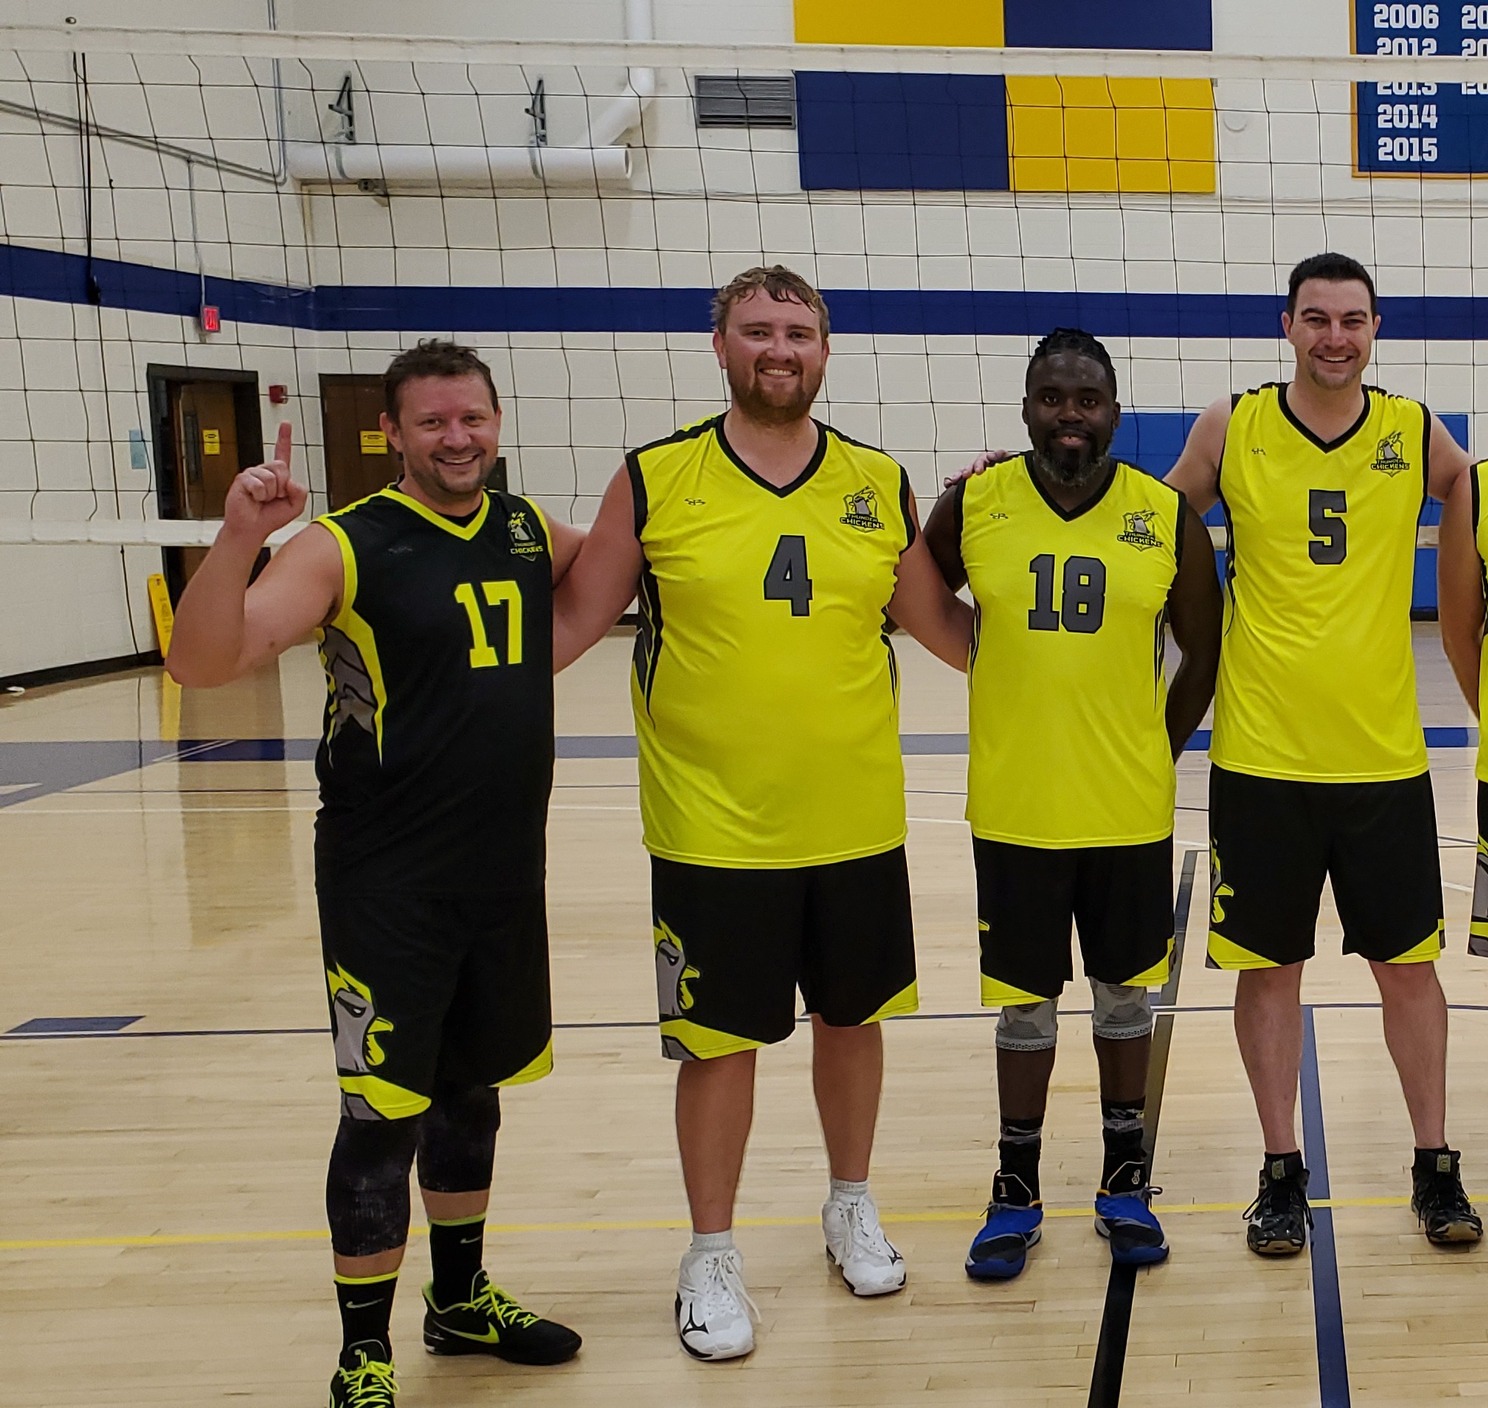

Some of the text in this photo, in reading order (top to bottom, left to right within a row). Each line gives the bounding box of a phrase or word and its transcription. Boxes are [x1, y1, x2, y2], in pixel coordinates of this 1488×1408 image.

[1373, 4, 1439, 29] 2006
[1376, 37, 1437, 56] 2012
[1377, 104, 1438, 129] 2014
[1377, 137, 1438, 162] 2015
[1308, 489, 1347, 565] 5
[763, 534, 813, 617] 4
[1027, 553, 1107, 635] 18
[454, 580, 523, 669] 17
